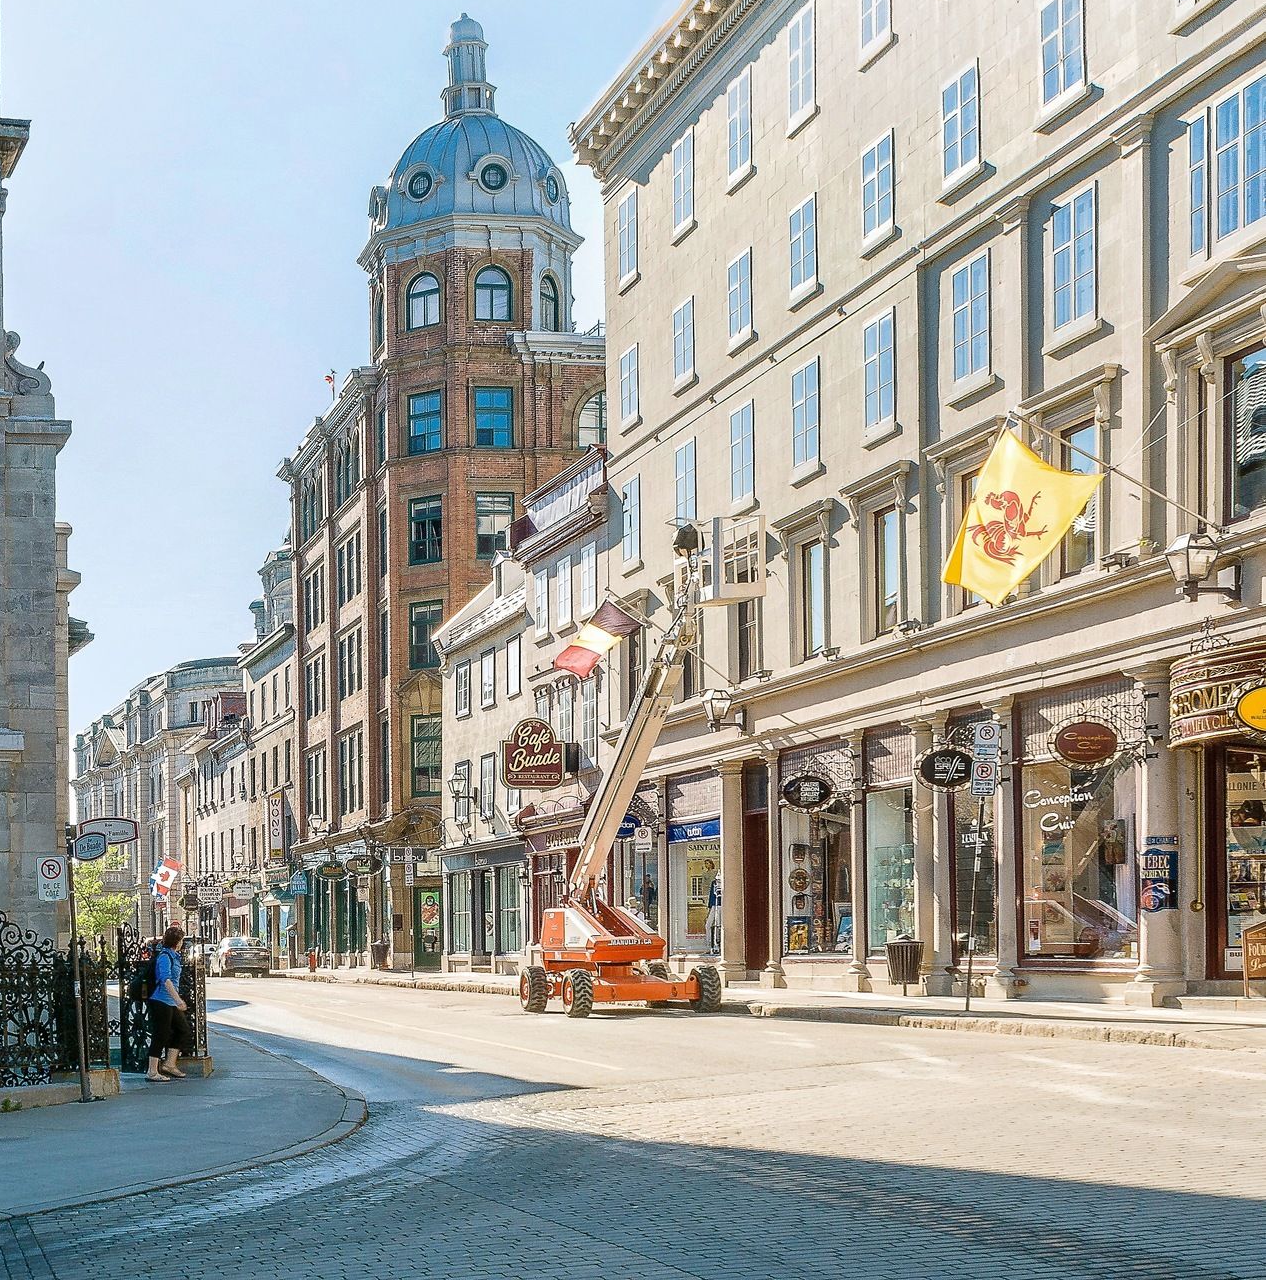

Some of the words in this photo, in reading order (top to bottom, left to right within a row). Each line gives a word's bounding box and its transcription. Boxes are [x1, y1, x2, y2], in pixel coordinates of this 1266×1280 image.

[517, 724, 551, 753] Café
[1077, 741, 1102, 749] Cuir
[508, 748, 560, 772] Buade
[1022, 787, 1094, 809] Conception
[270, 799, 280, 838] WONG
[1040, 812, 1076, 832] Cuir
[106, 829, 129, 837] -Famille
[393, 849, 424, 861] biou
[45, 889, 60, 897] CÔTÉ
